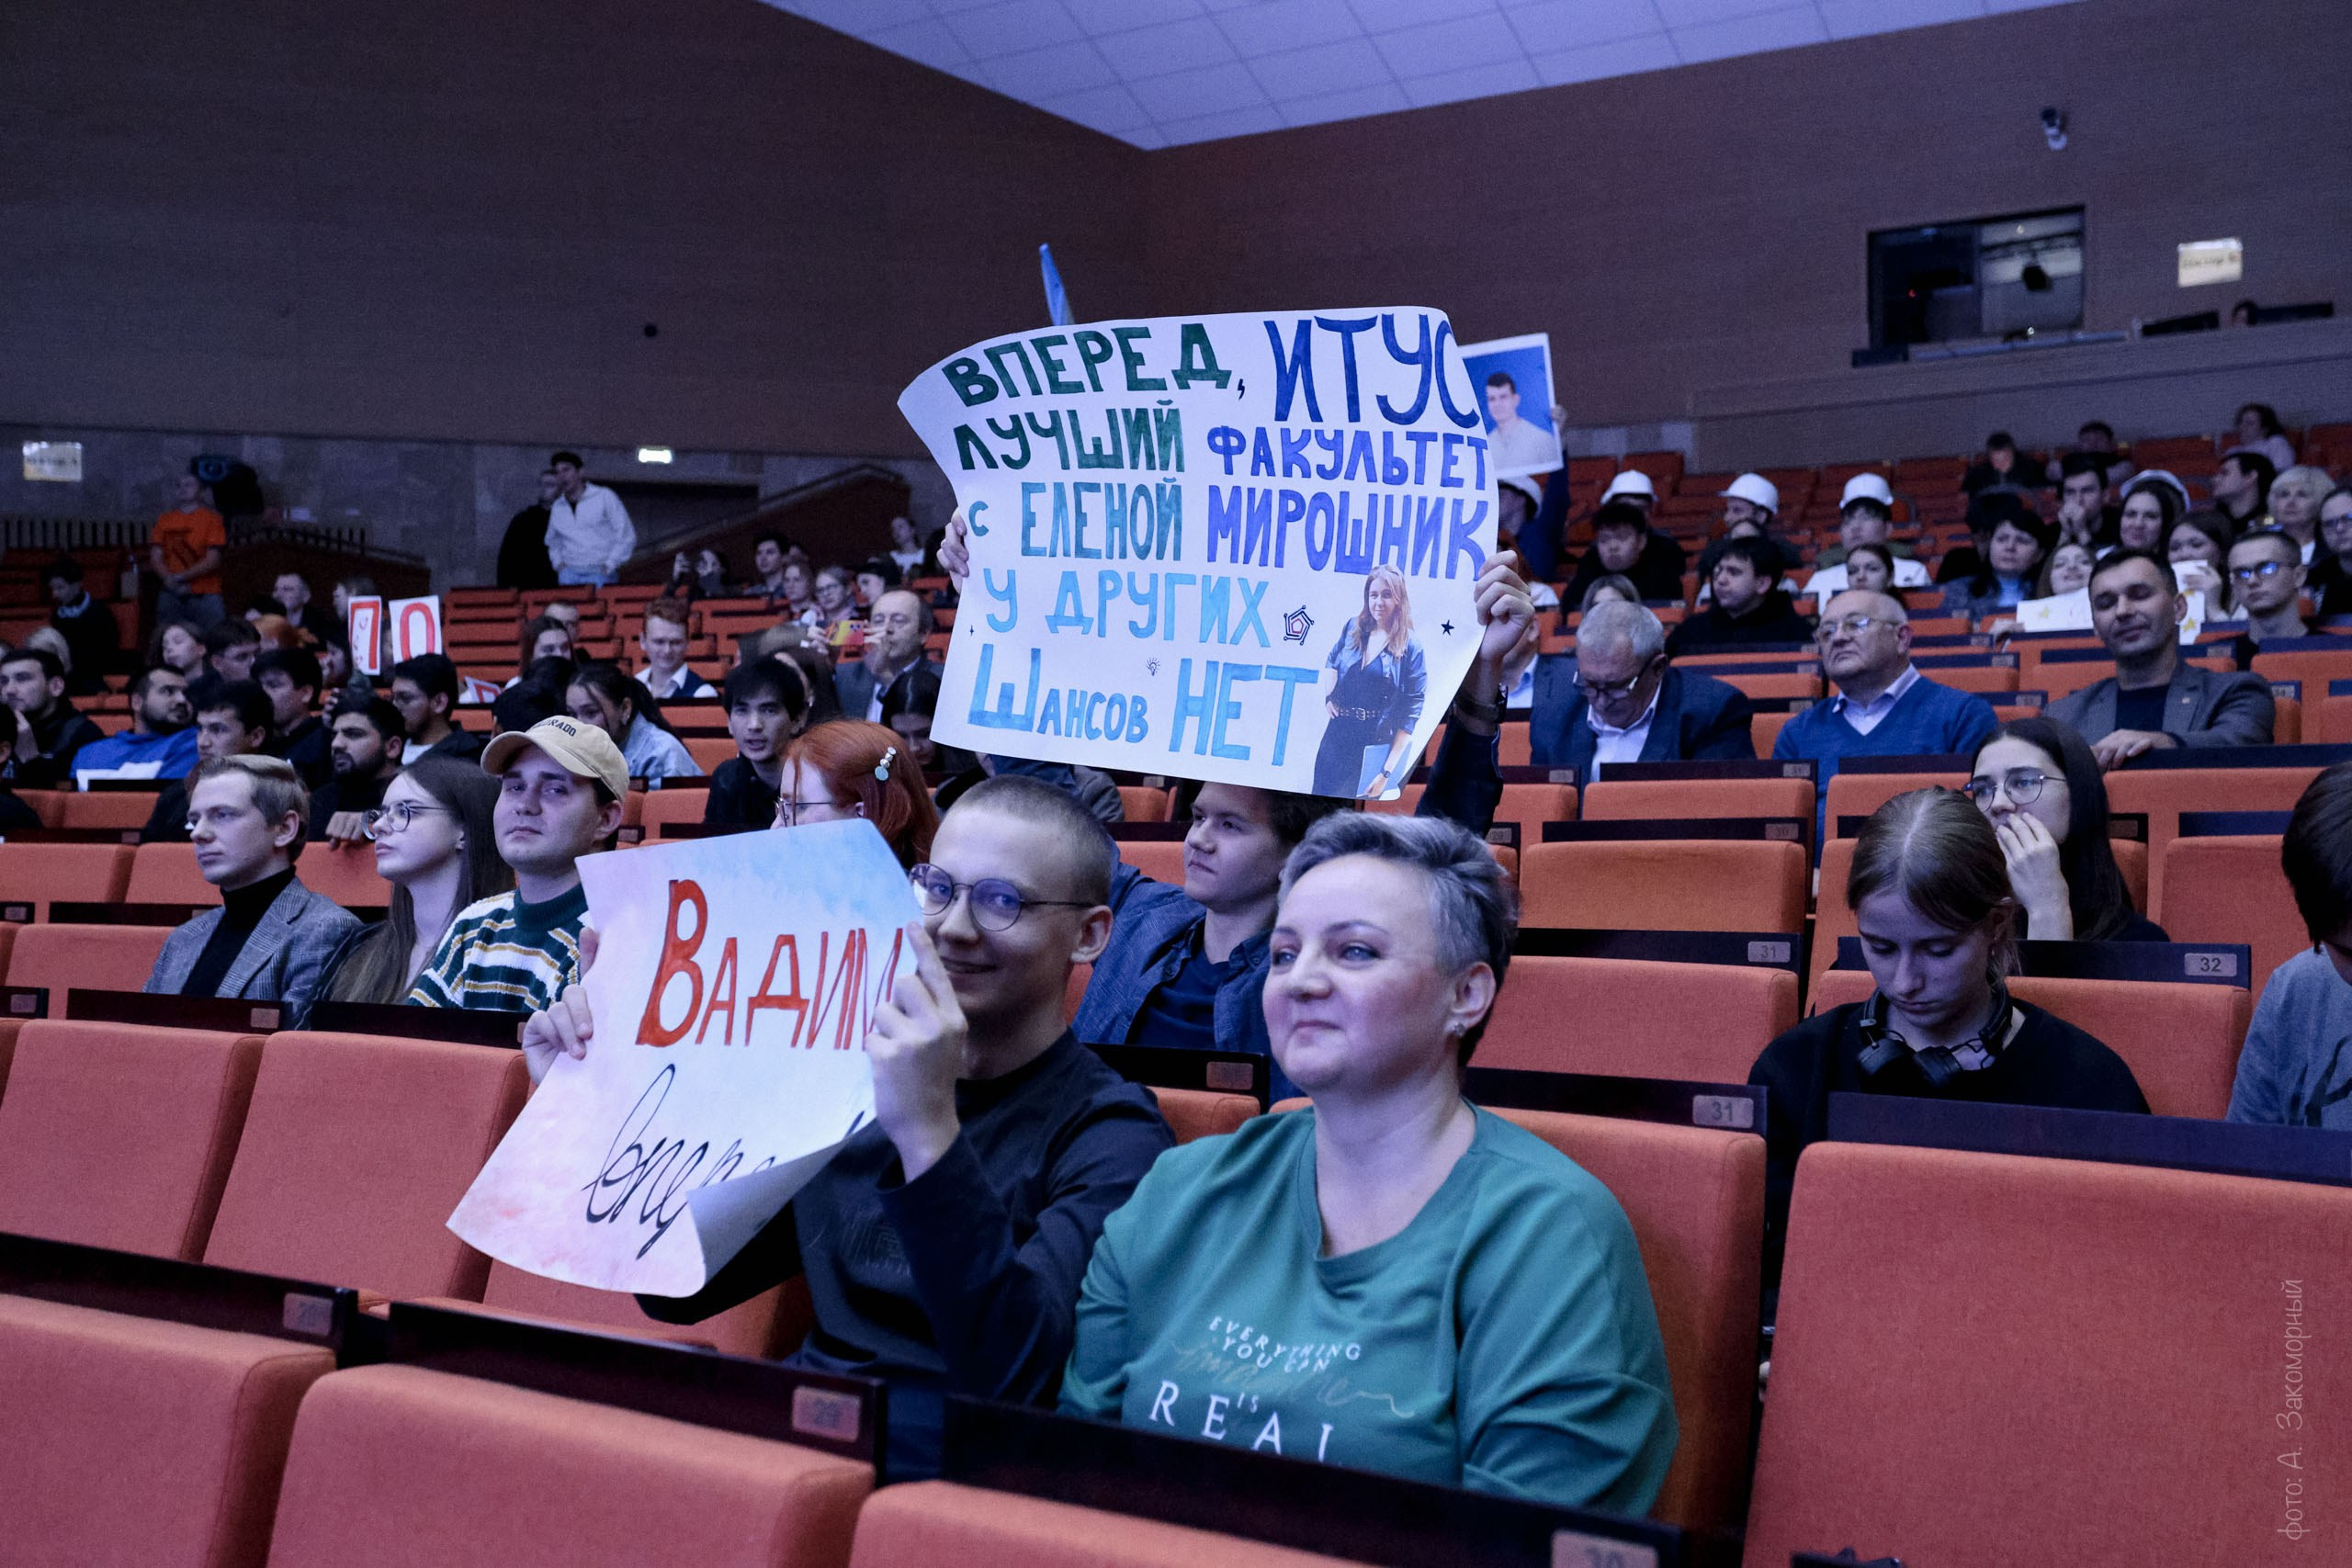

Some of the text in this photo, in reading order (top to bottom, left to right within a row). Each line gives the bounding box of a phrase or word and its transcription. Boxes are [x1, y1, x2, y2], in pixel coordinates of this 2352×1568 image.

[942, 313, 1480, 428] ВПЕРЕД, ИТУС
[953, 399, 1488, 491] ЛУЧШИЙ ФАКУЛЬТЕТ
[1021, 478, 1182, 561] ЕЛЕНОЙ
[1207, 485, 1488, 581] МИРОШНИК
[983, 569, 1271, 648] У ДРУГИХ
[1169, 658, 1319, 766] НЕТ
[1760, 945, 1777, 959] 31
[2199, 956, 2222, 973] 32
[1711, 1101, 1734, 1122] 31
[1208, 1315, 1362, 1361] EVERYTHING
[1222, 1337, 1272, 1369] YOU
[1237, 1392, 1260, 1413] IS
